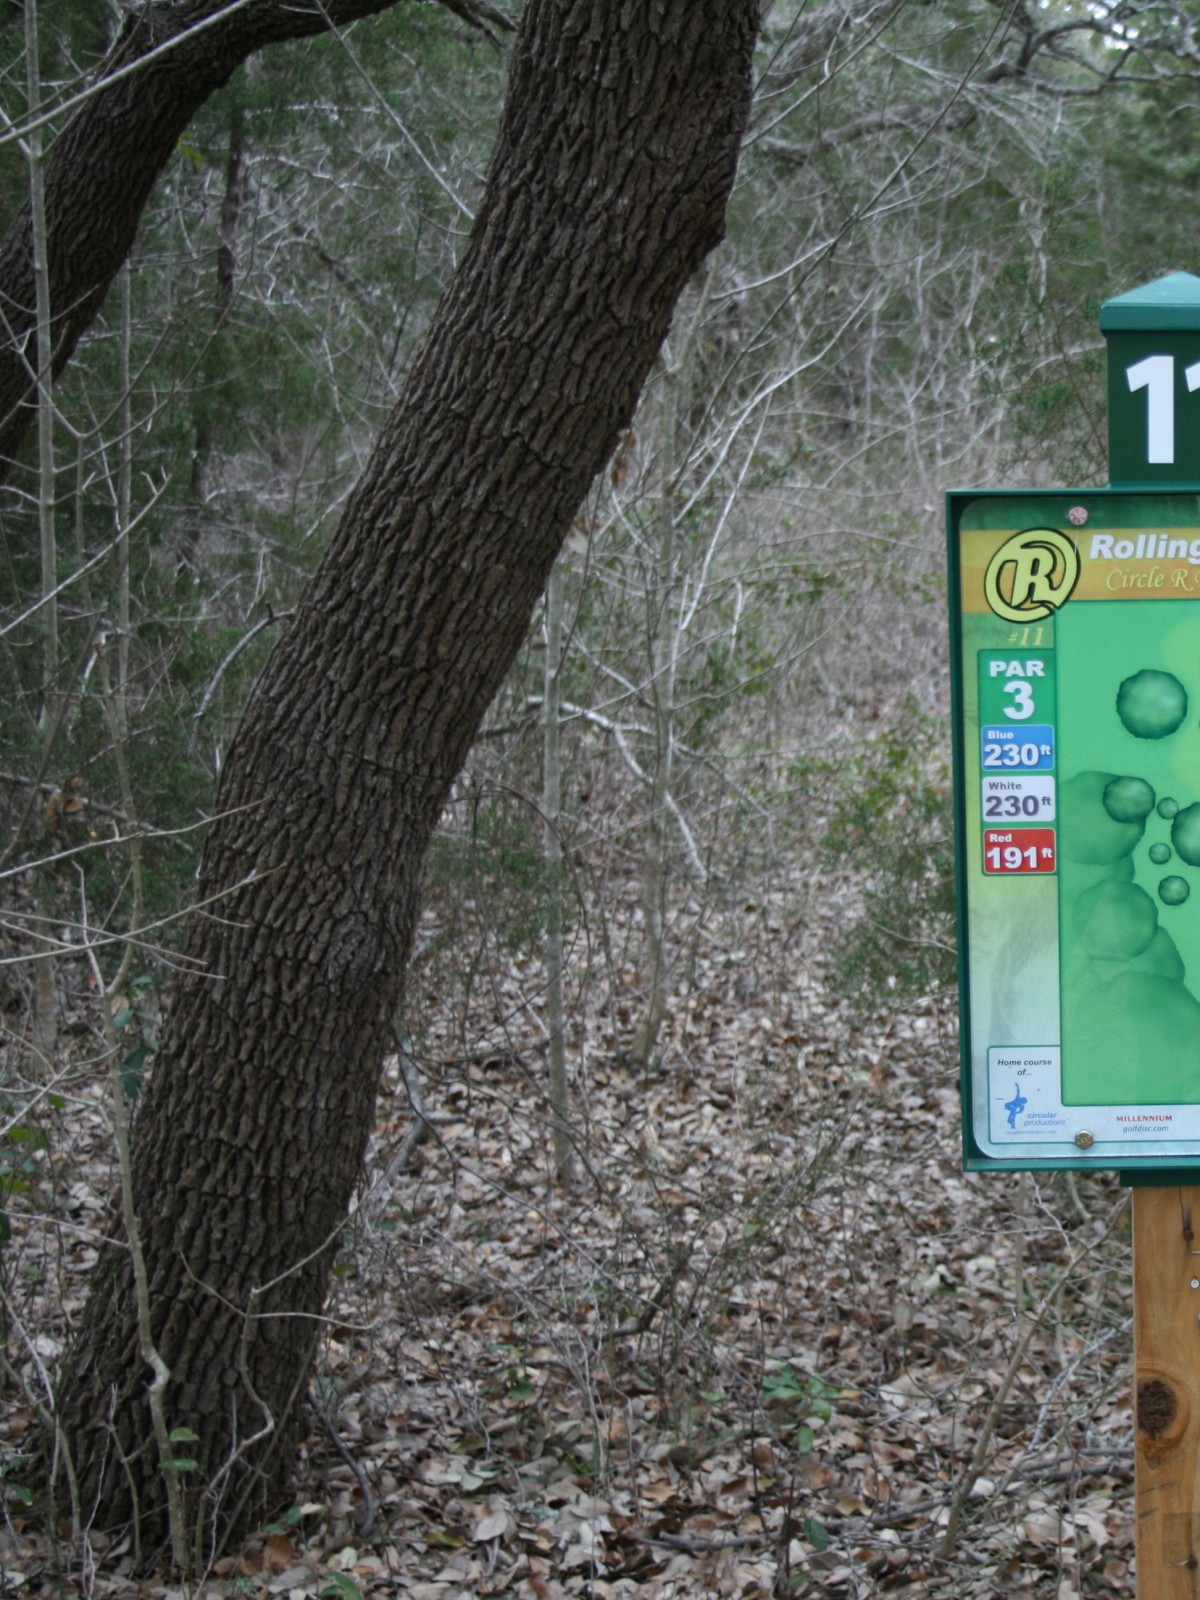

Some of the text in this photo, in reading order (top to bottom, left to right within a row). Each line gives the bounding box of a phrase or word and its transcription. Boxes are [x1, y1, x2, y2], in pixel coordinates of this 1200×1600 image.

[1106, 566, 1165, 591] Circle
[1171, 568, 1194, 592] R
[989, 660, 1046, 678] PAR
[1003, 680, 1035, 720] 3
[987, 730, 1015, 740] Blue
[988, 782, 1022, 791] White
[989, 834, 1013, 843] Red
[1023, 1119, 1067, 1127] productions
[1116, 1114, 1174, 1122] MILLENNIUM
[1122, 1125, 1170, 1135] golfdisc.com
